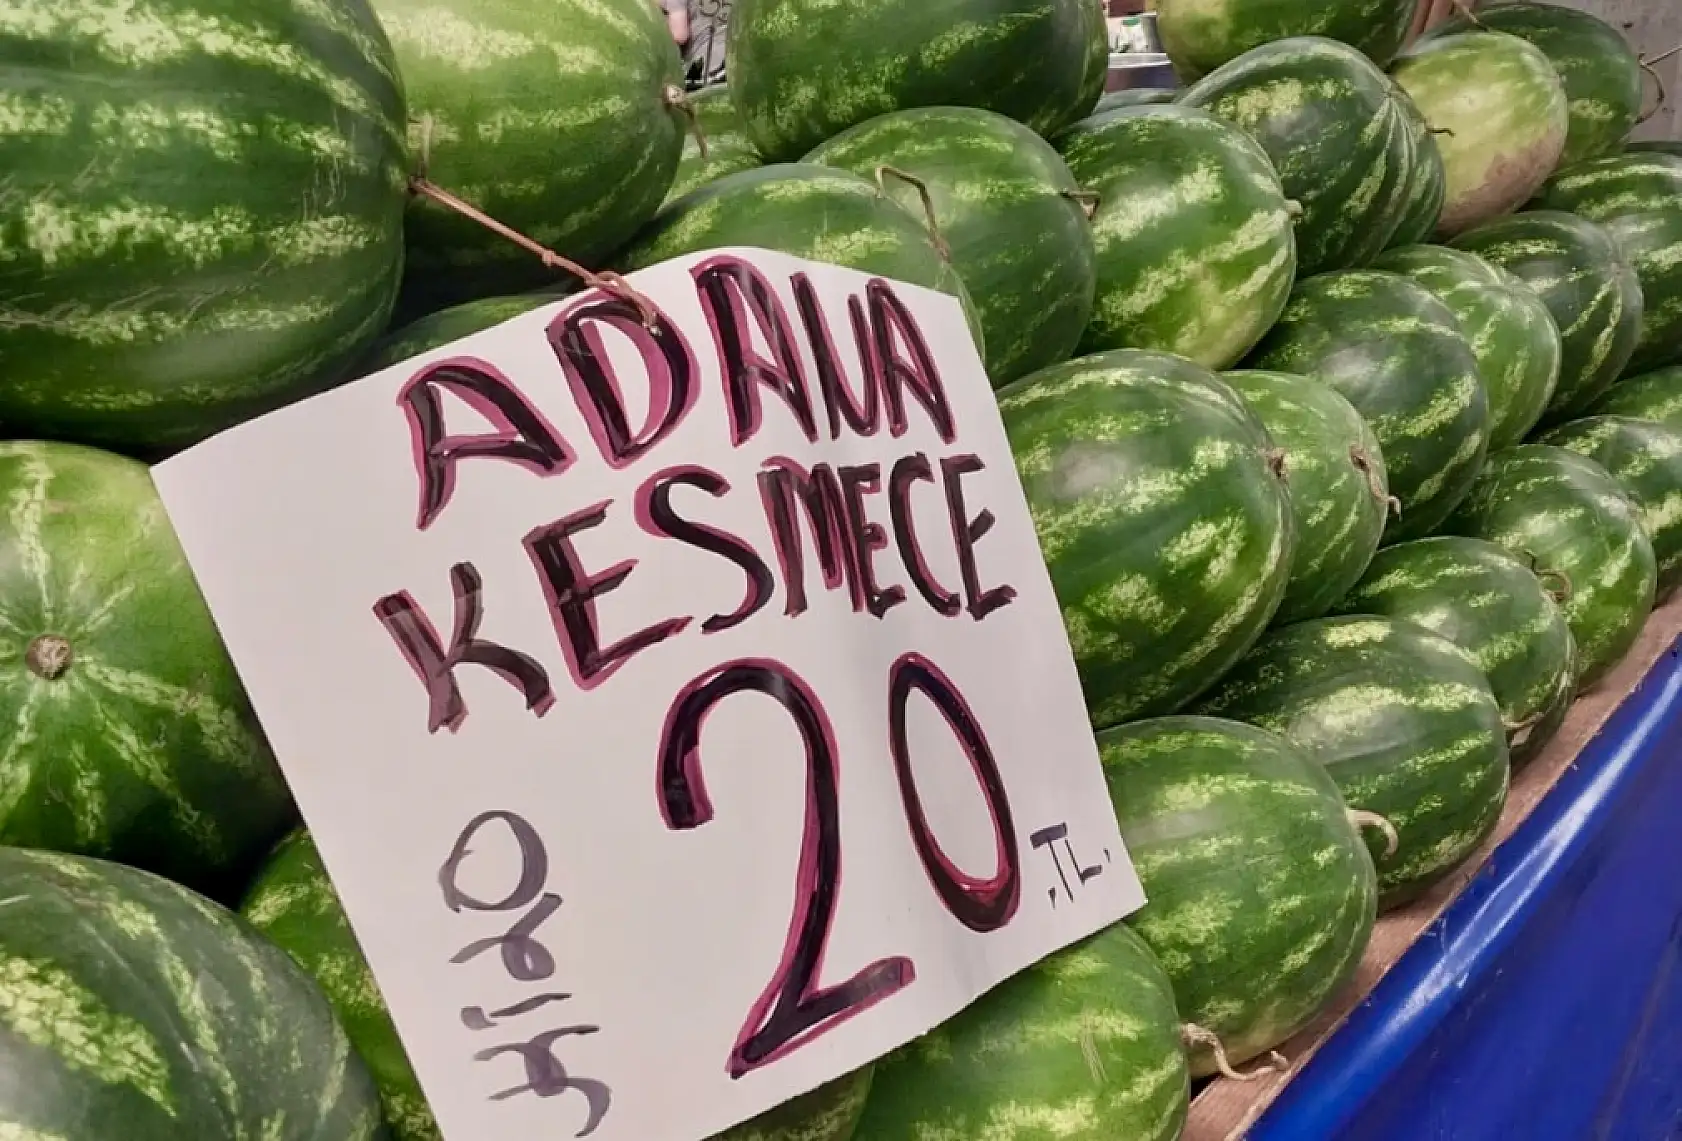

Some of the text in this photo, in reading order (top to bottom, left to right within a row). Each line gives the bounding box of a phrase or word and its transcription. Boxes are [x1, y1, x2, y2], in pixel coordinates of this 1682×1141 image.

[396, 255, 957, 530] ADANA
[373, 453, 1017, 734] KESMECE
[656, 652, 1020, 1079] 20
